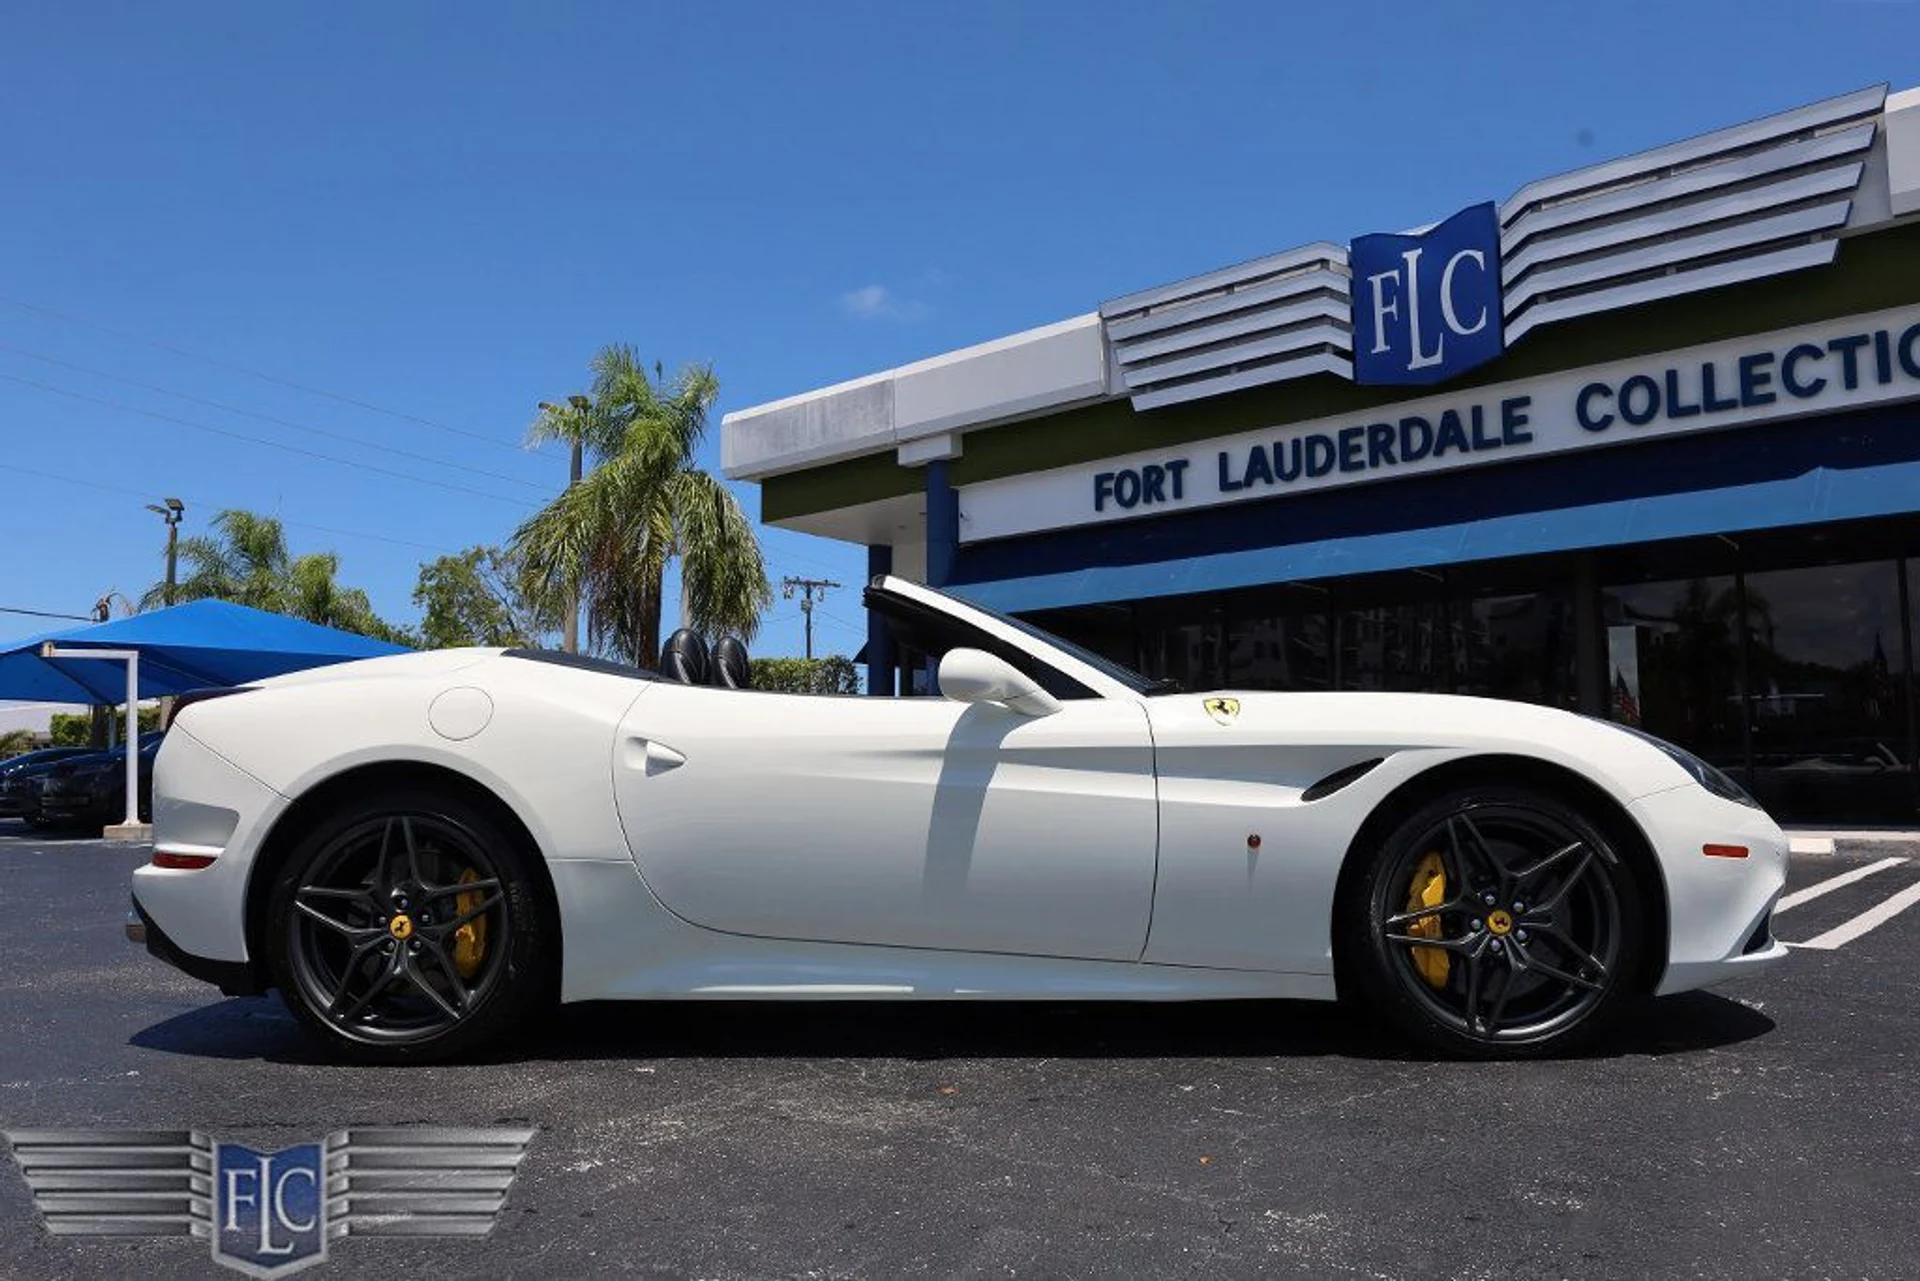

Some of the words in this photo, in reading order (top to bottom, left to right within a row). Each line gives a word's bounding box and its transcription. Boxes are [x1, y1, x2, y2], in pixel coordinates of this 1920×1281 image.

[1367, 248, 1487, 370] FLC
[1094, 459, 1189, 511] FORT
[1218, 396, 1533, 491] LAUDERDALE
